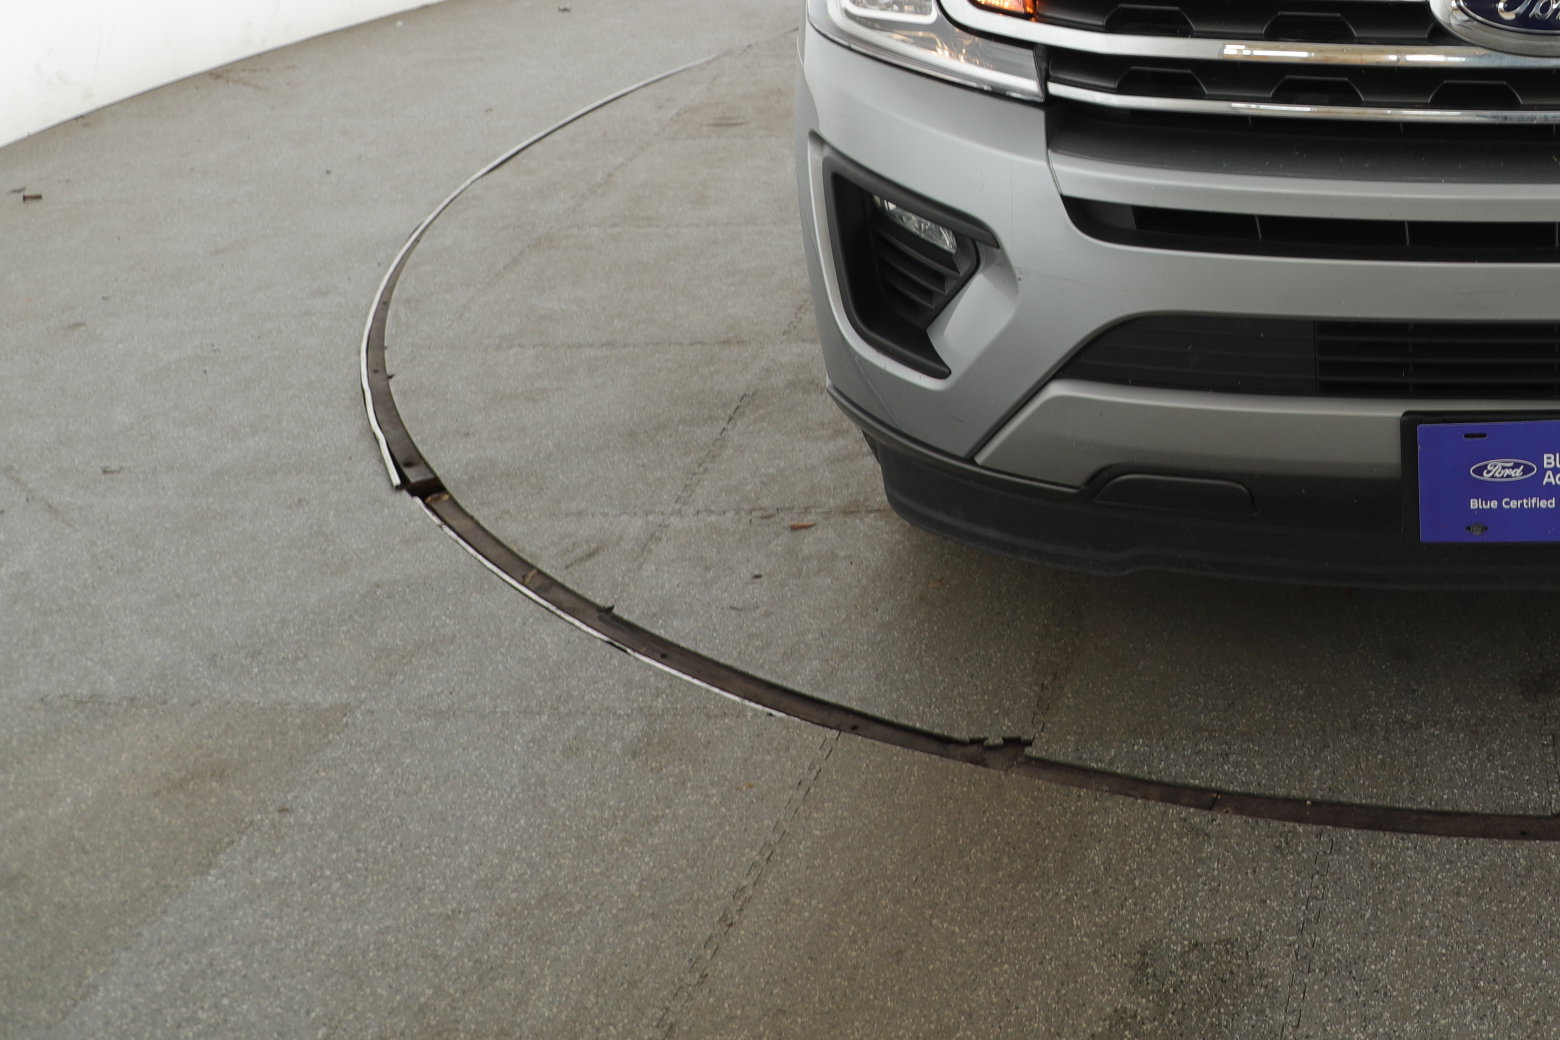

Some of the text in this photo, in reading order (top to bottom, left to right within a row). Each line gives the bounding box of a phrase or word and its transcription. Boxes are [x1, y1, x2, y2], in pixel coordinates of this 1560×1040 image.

[1483, 461, 1526, 479] Ford
[1471, 499, 1497, 509] Blue
[1502, 497, 1555, 508] Certified
